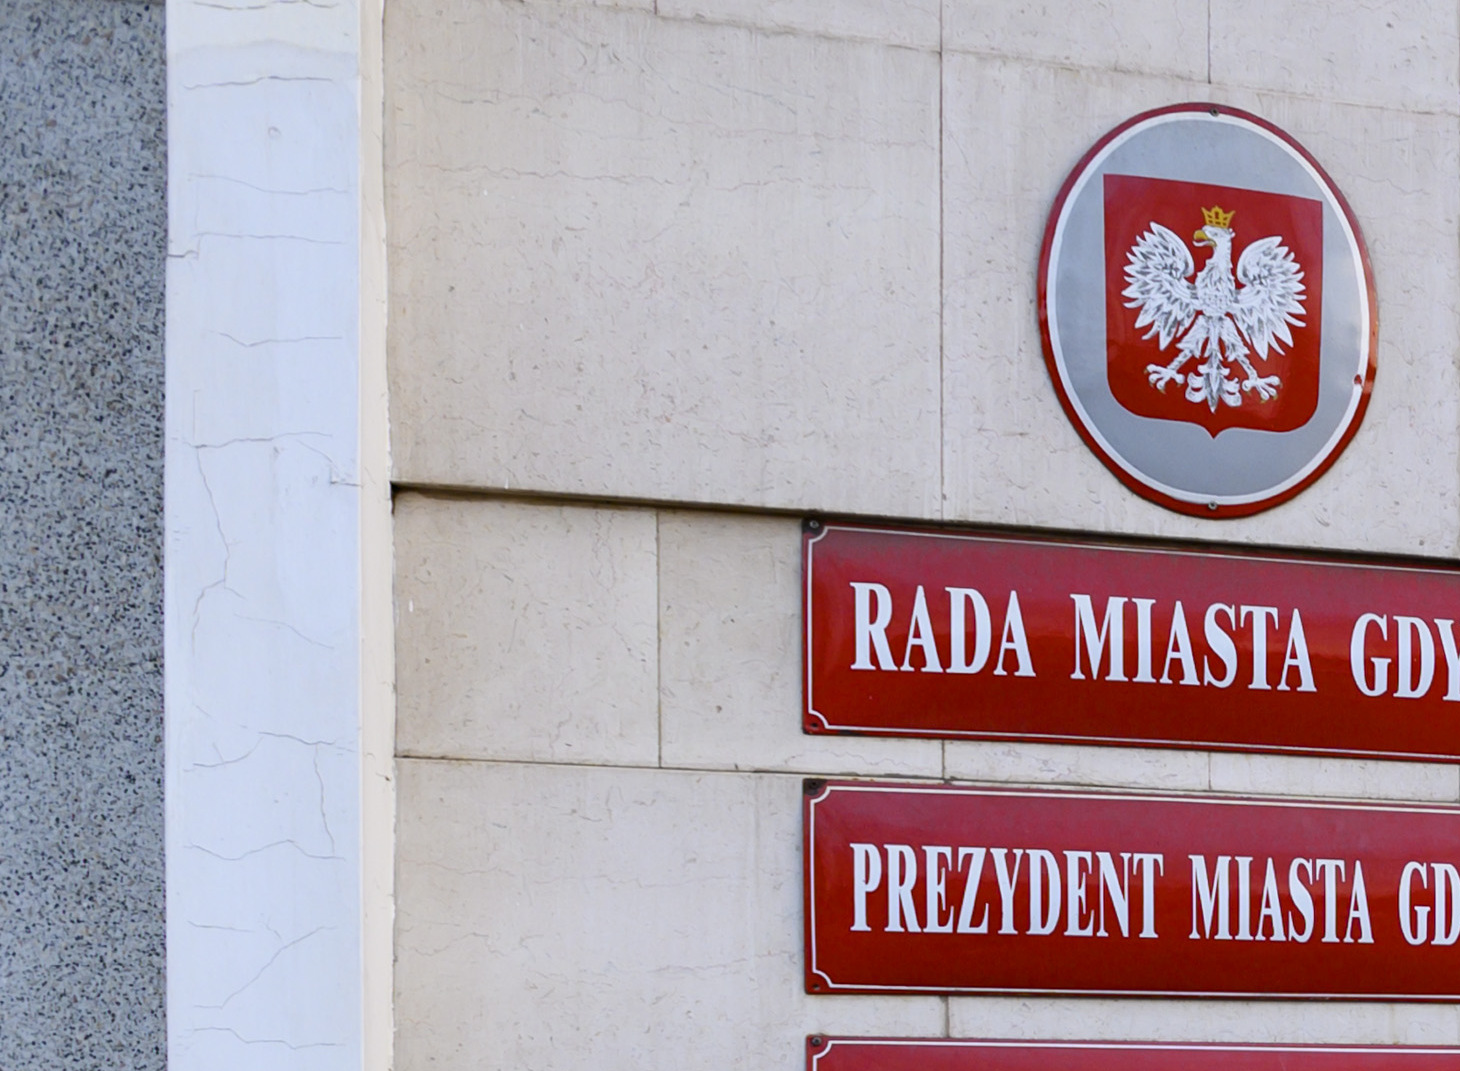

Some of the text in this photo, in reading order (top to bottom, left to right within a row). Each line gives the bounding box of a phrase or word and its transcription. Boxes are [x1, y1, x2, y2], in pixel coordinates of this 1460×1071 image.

[850, 582, 1036, 677] RADA
[1070, 593, 1317, 692] MIASTA
[850, 843, 1164, 939] PREZYDENT
[1189, 853, 1375, 945] MIASTA
